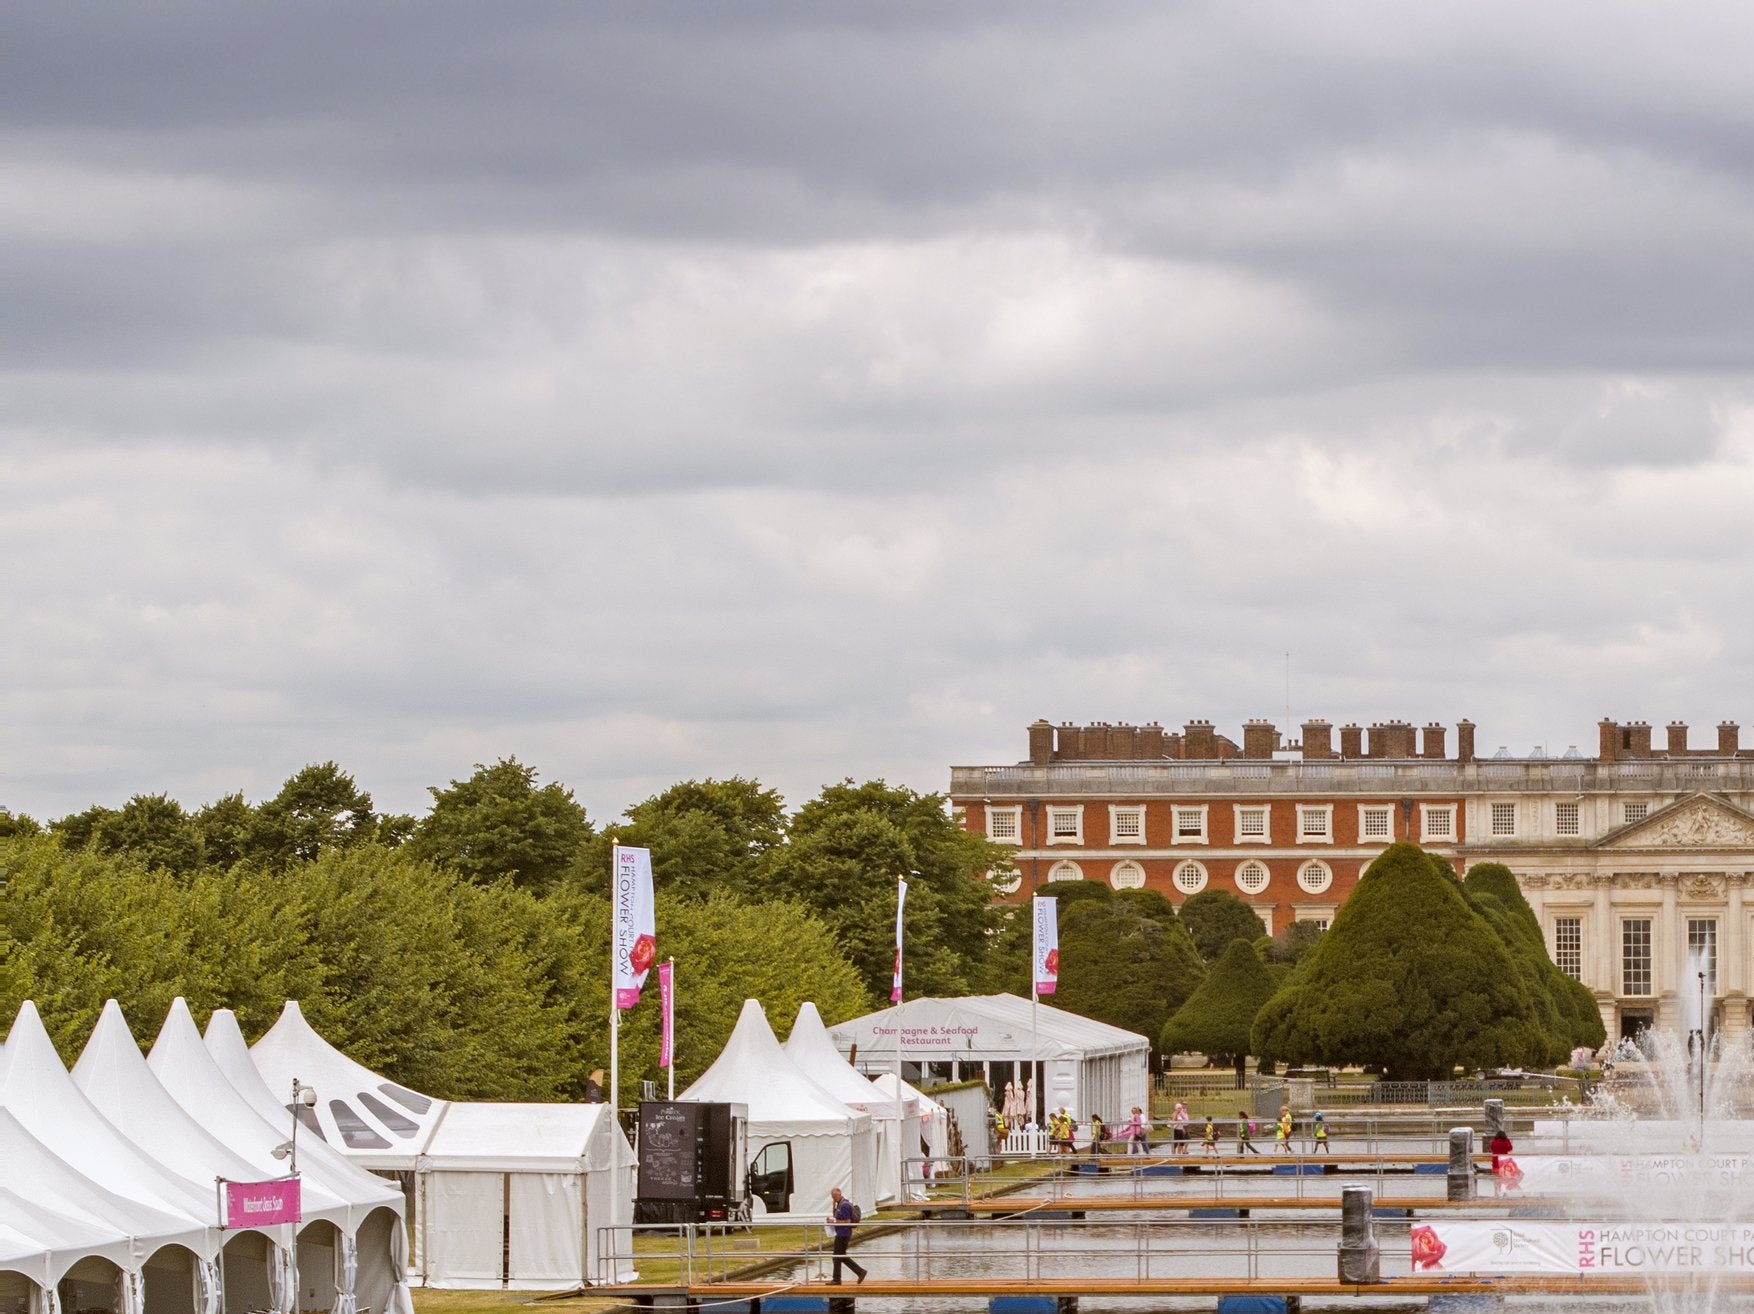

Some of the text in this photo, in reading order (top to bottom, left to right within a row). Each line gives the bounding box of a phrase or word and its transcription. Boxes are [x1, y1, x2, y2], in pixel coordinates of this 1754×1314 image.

[620, 853, 635, 863] RHS
[619, 865, 630, 975] FLOWER SHOW
[931, 1027, 940, 1035] &
[940, 1026, 978, 1035] Seafood
[900, 1036, 952, 1045] Restaurant
[1600, 1229, 1678, 1242] HAMPTON
[1684, 1229, 1737, 1241] COURT
[1578, 1230, 1595, 1267] RHS
[1601, 1246, 1703, 1266] FLOWER
